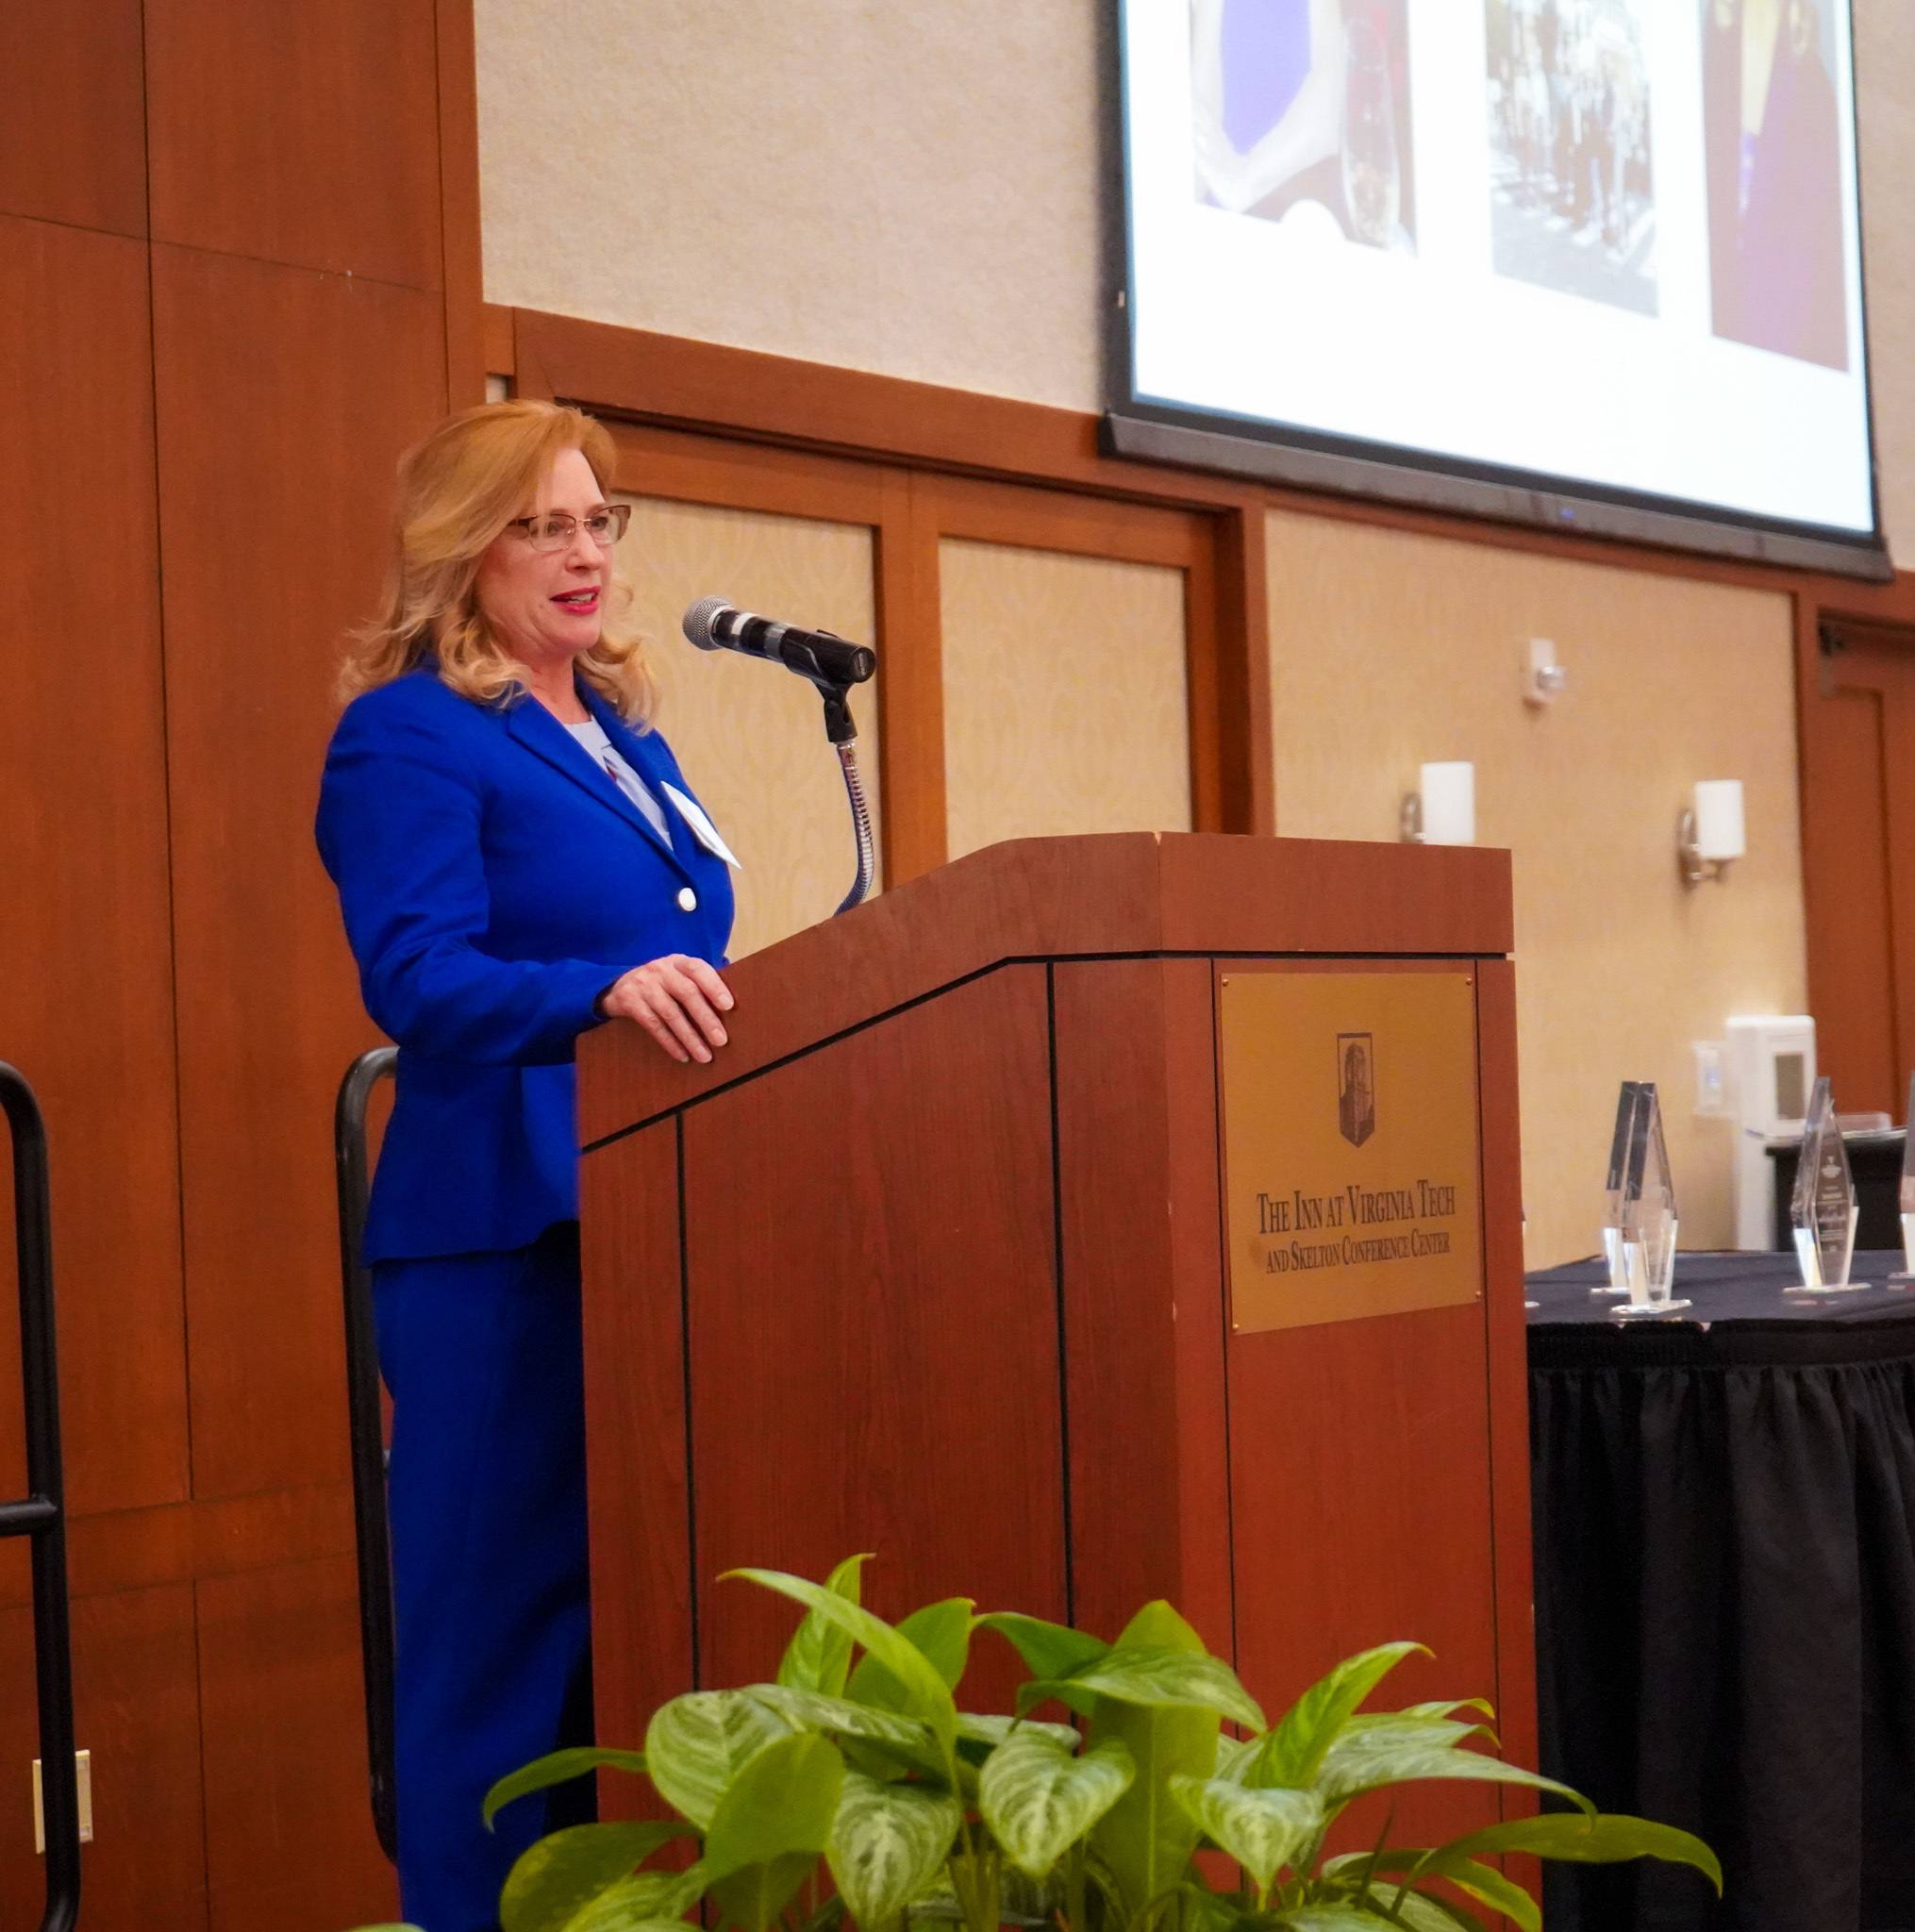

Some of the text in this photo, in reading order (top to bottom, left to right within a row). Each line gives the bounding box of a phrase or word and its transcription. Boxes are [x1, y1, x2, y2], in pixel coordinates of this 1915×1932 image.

[1257, 1179, 1456, 1234] THE INN AT VIRGINIA TECH
[1266, 1228, 1451, 1274] AND SKELTON CONFERENCE CENTER
